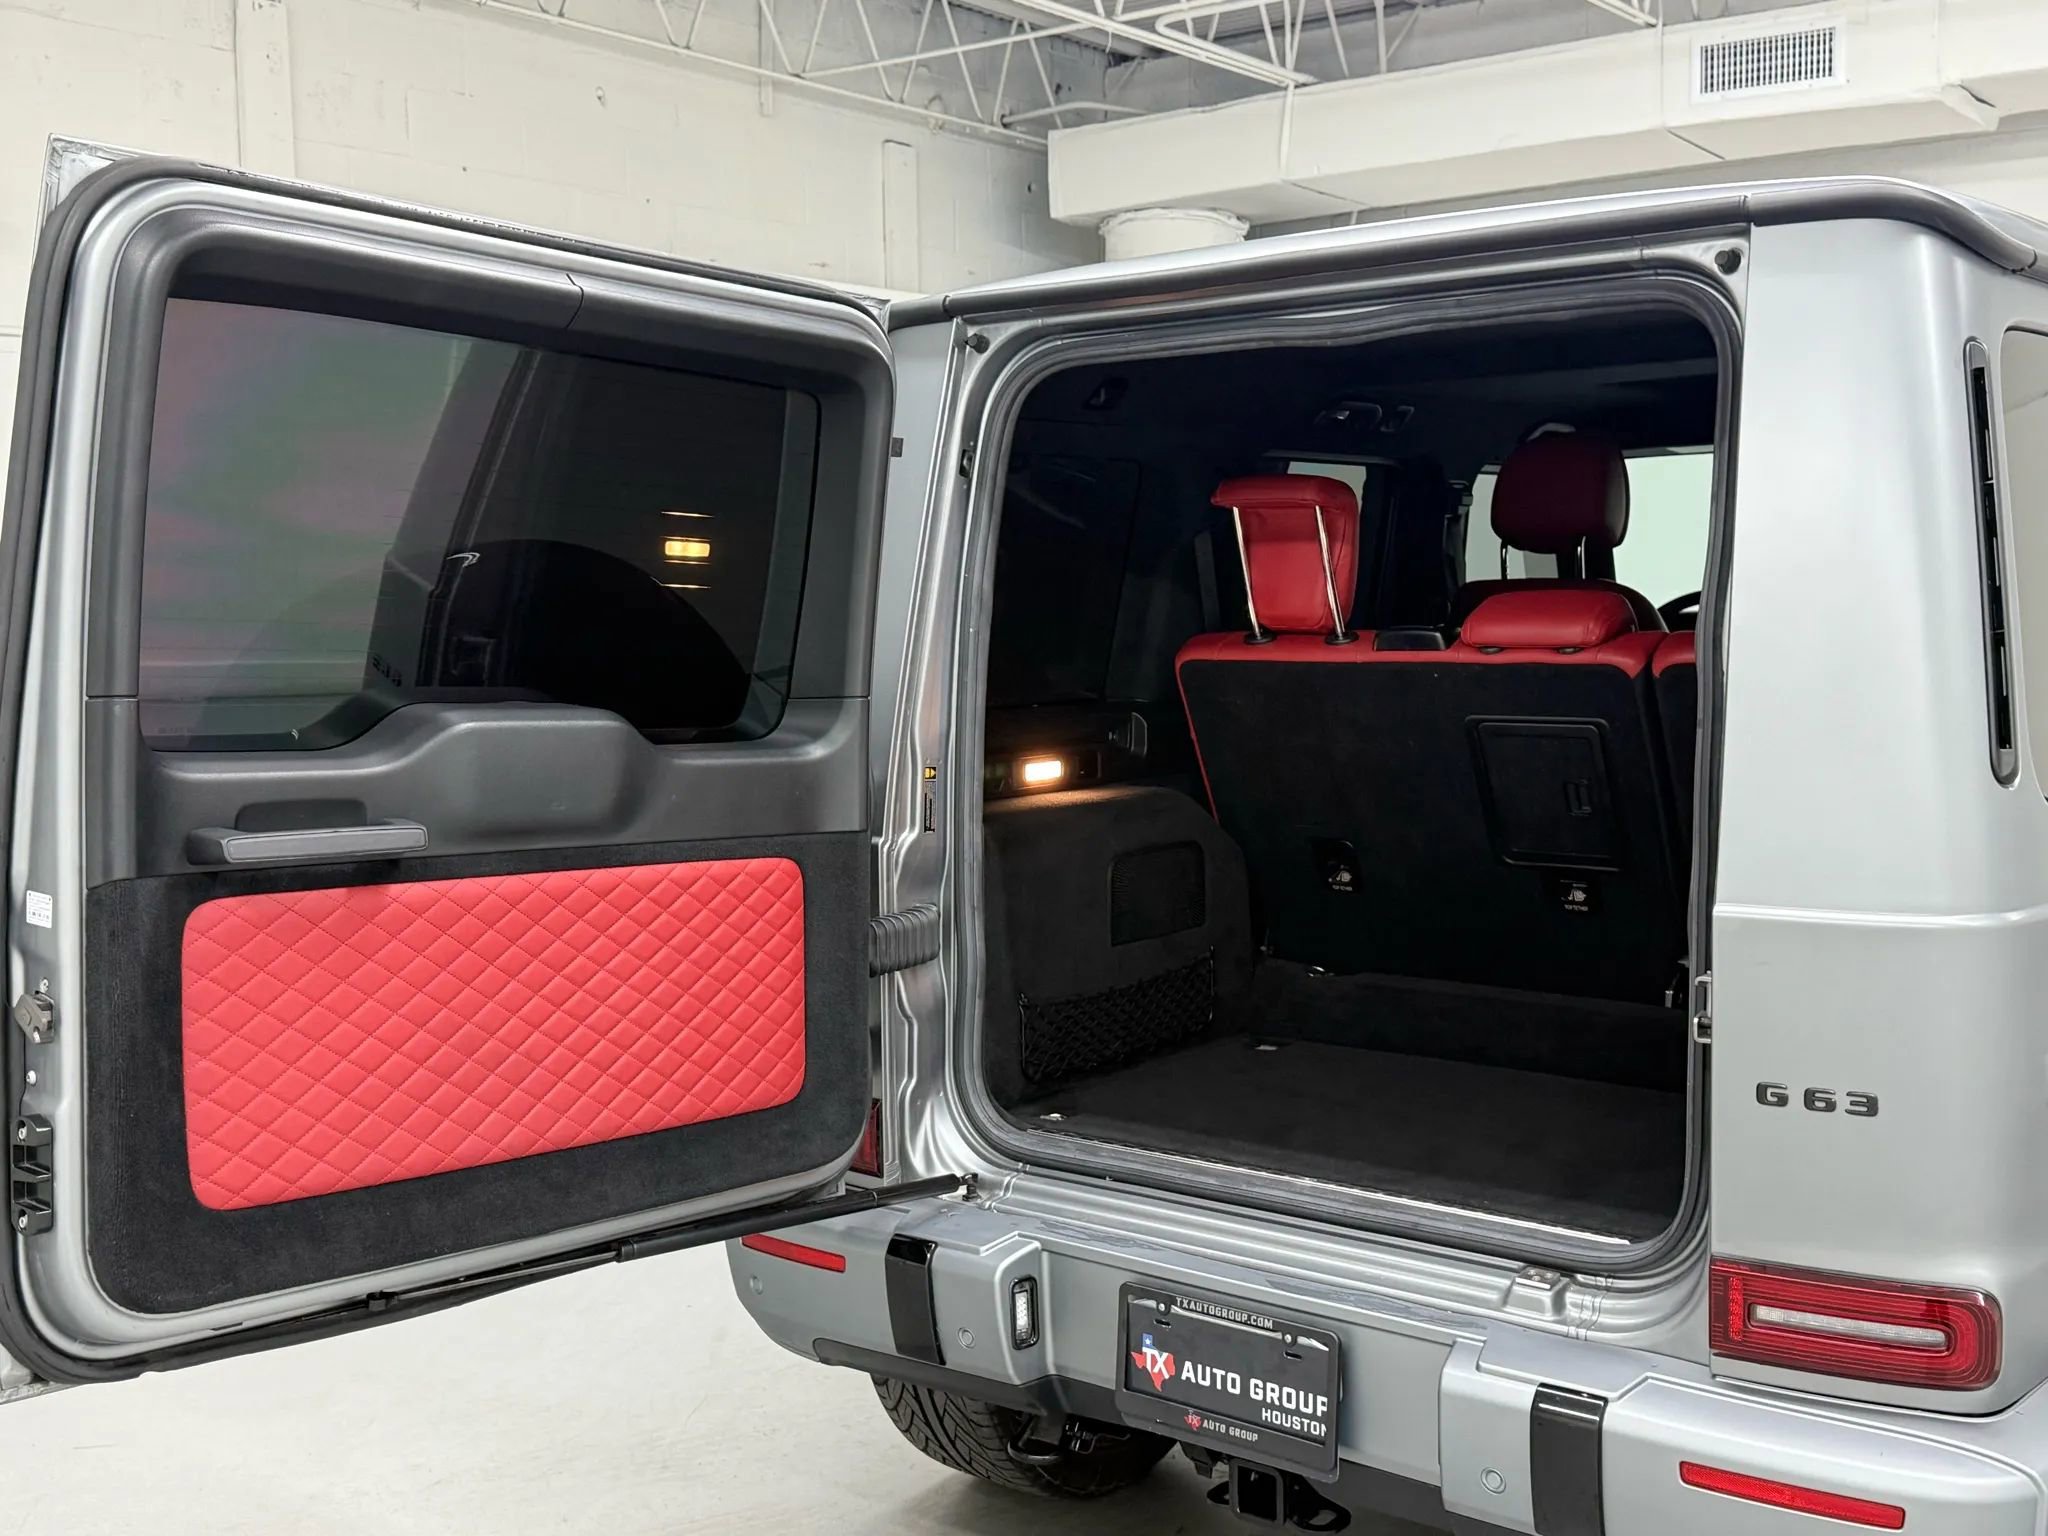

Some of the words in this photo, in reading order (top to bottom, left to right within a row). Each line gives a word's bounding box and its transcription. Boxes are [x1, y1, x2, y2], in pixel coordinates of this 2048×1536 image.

[1756, 1082, 1789, 1107] G
[1803, 1087, 1879, 1117] 63
[1176, 1297, 1273, 1329] TXAUTOGROUP.COM
[1142, 1346, 1170, 1380] TX
[1181, 1360, 1241, 1395] AUTO
[1250, 1378, 1327, 1417] GROUP
[1203, 1419, 1226, 1433] AUTO
[1229, 1426, 1258, 1442] GROUP
